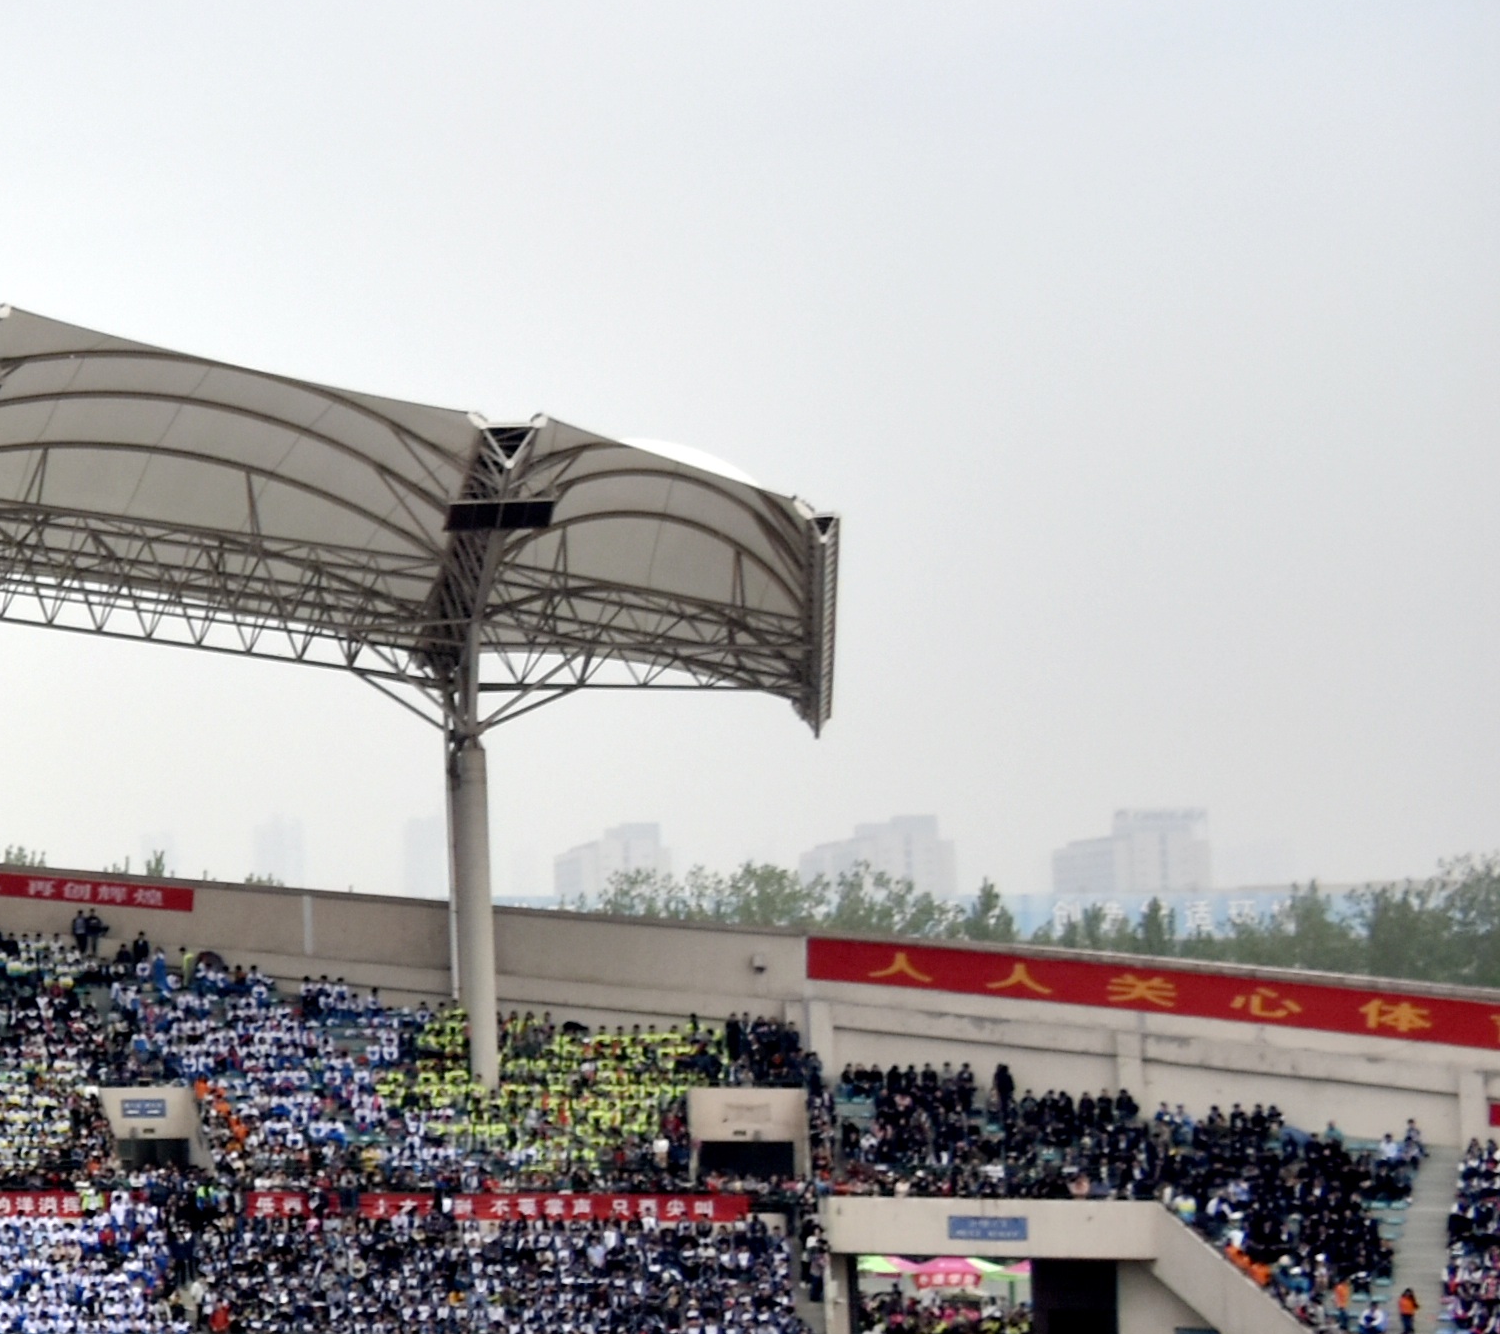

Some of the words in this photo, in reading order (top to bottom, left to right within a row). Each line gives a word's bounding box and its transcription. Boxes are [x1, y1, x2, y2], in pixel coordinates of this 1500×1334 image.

[867, 951, 1500, 1045] 人人关心体
